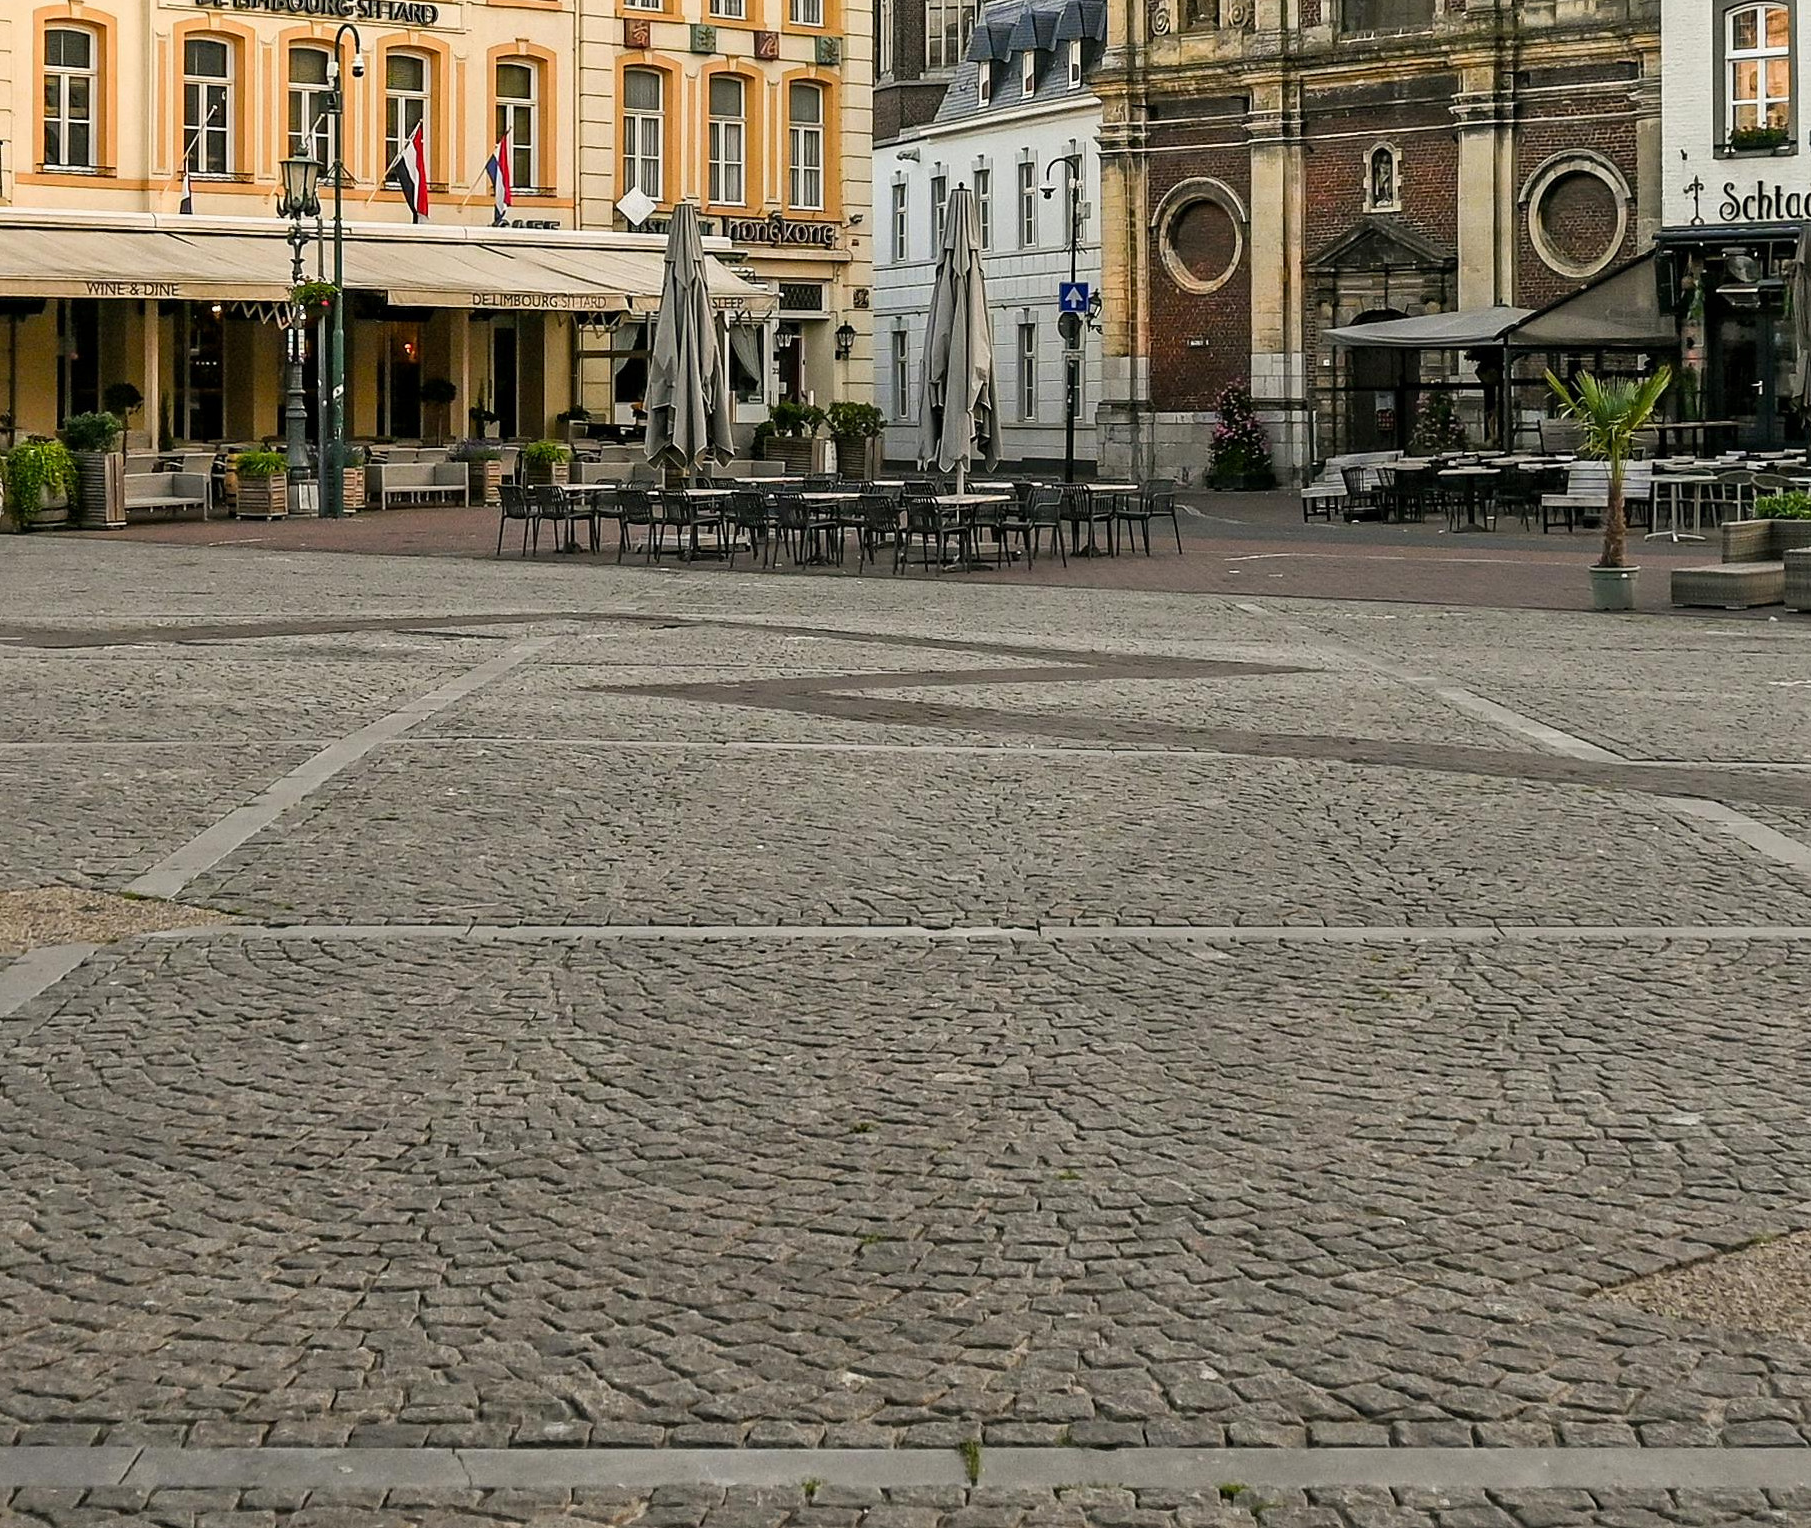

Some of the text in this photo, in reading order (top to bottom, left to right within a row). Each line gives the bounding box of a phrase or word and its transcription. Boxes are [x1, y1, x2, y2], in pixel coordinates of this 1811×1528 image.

[85, 281, 180, 297] WINE & DINE
[472, 293, 607, 309] DE LIMBOURG SITTARD
[711, 296, 744, 309] SLEEP
